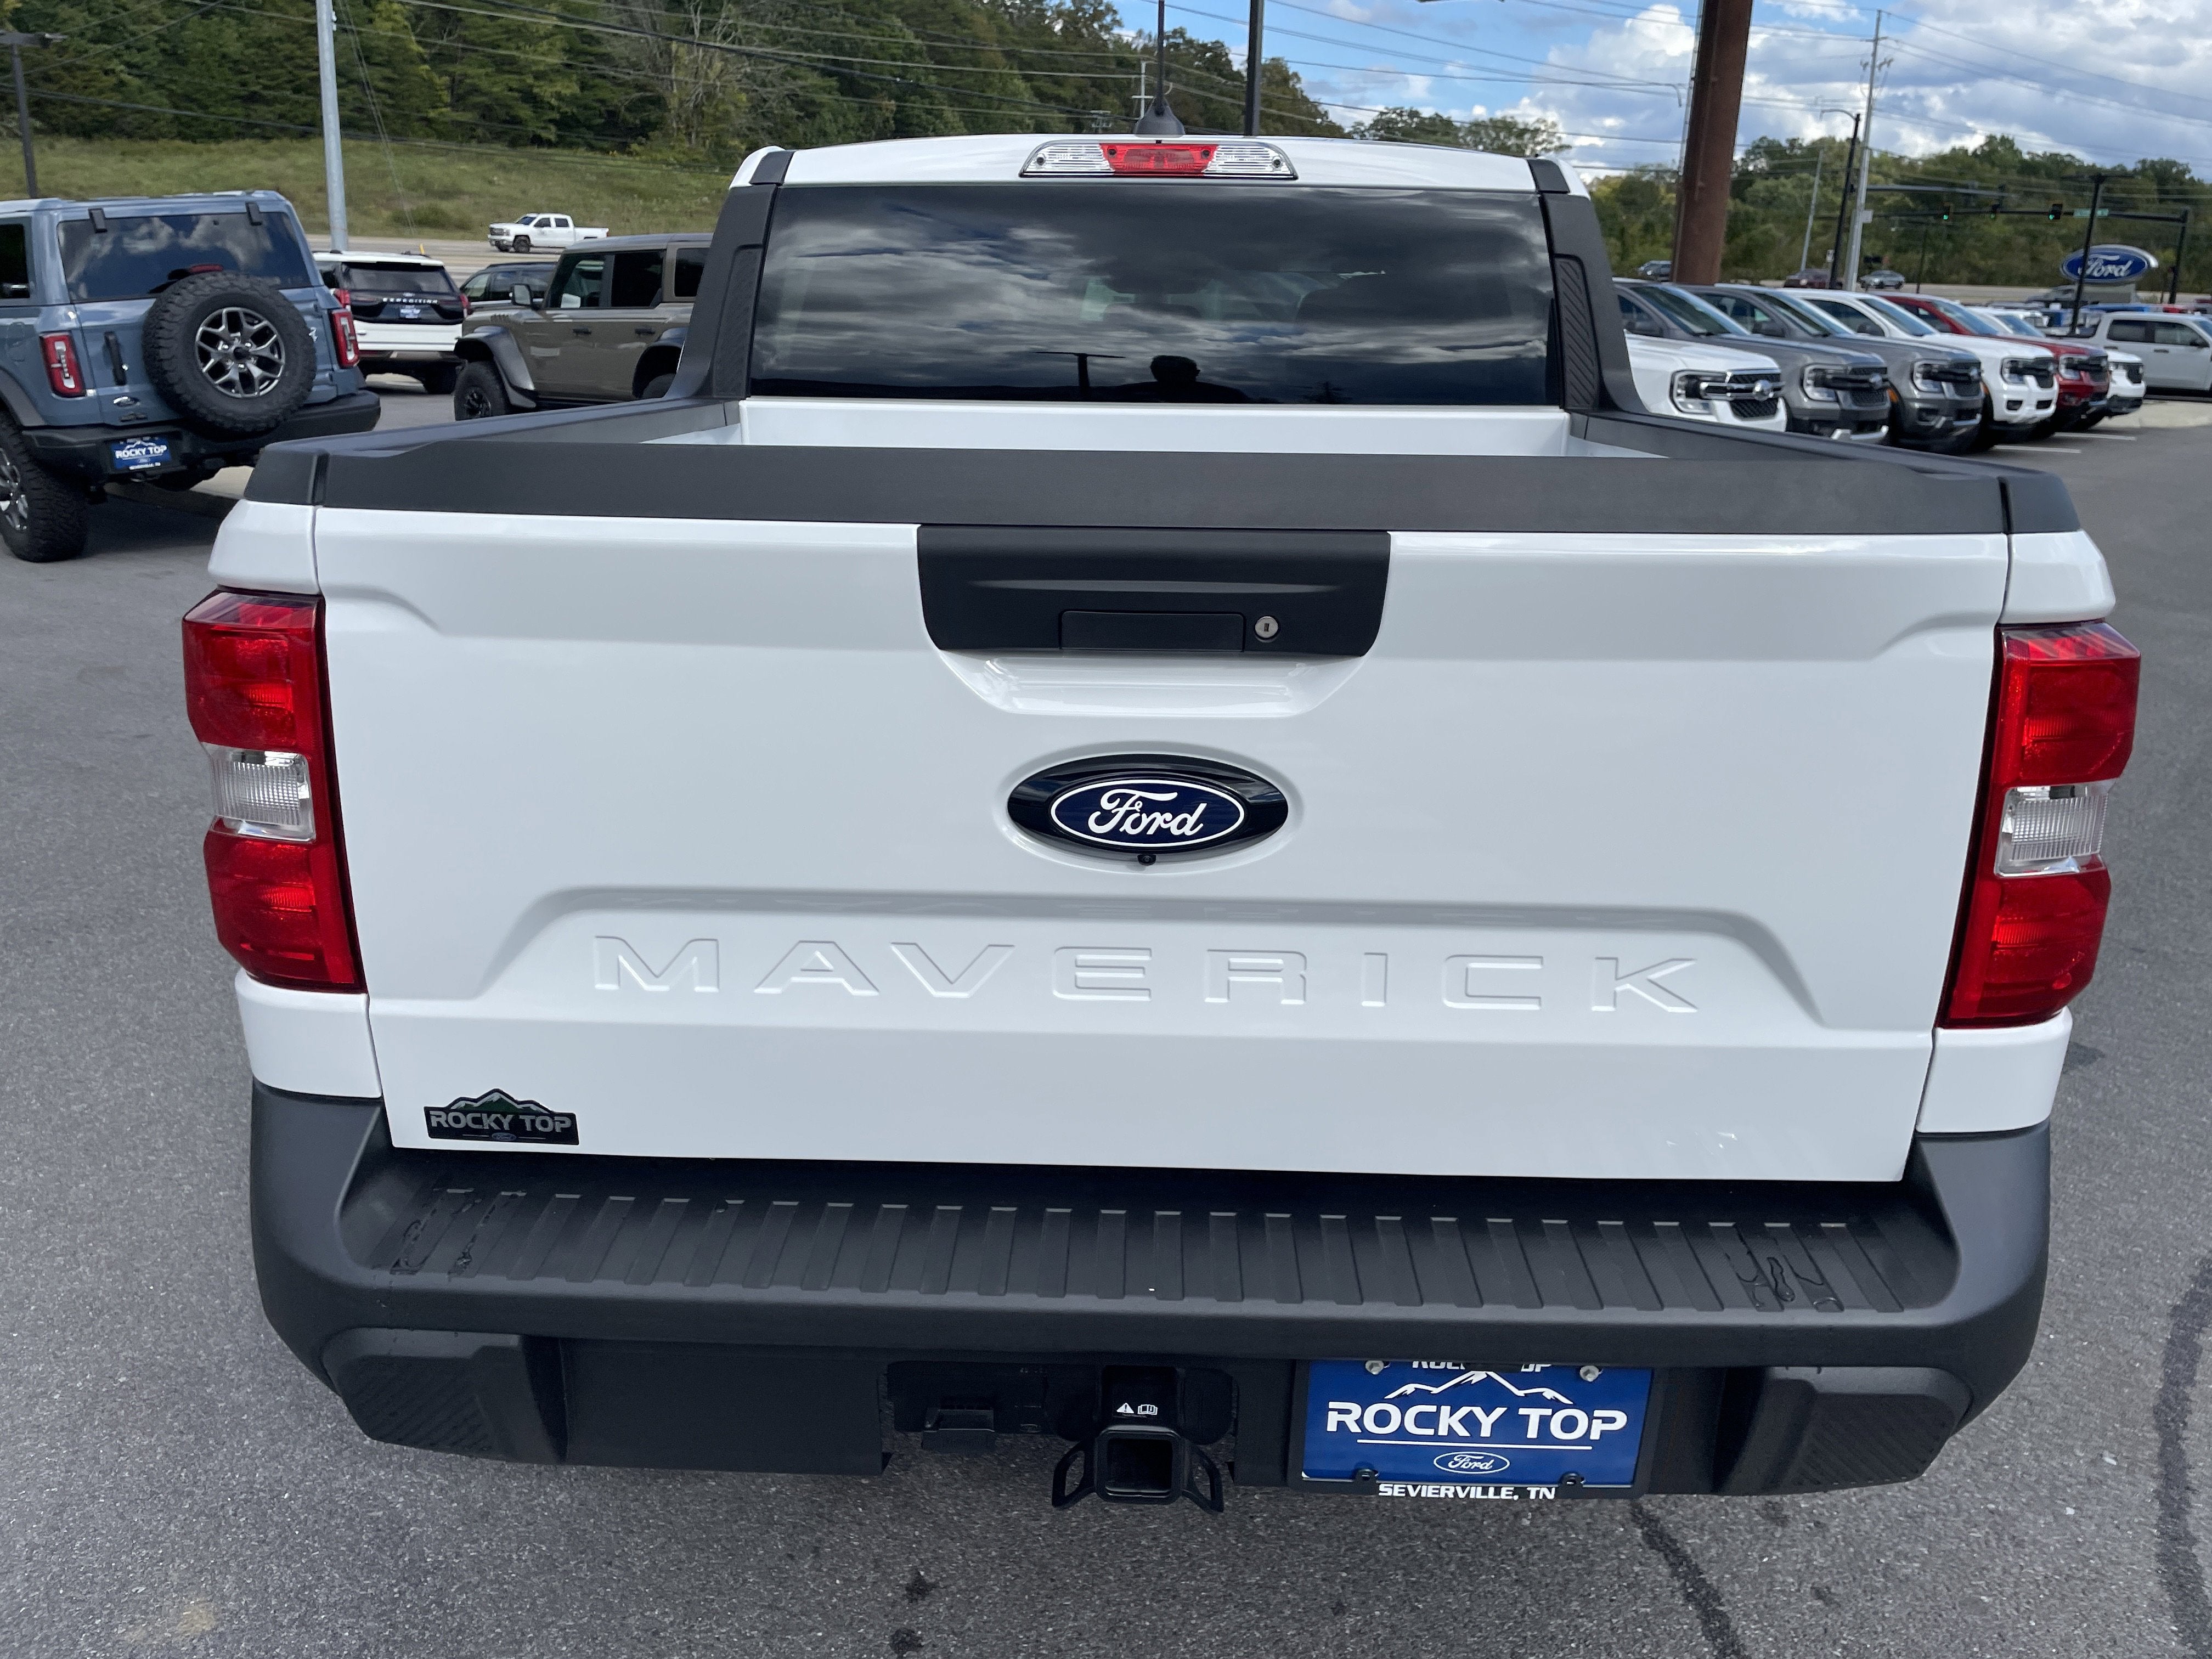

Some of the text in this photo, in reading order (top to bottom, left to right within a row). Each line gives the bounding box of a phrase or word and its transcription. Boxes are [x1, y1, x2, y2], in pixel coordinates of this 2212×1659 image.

[2078, 254, 2133, 276] Ford
[115, 445, 167, 458] ROCKY TOP
[1088, 788, 1207, 836] Ford
[595, 935, 1698, 1013] MAVERICK
[430, 1110, 572, 1133] ROCKY TOP
[1326, 1401, 1628, 1440] ROCKY TOP
[1447, 1451, 1496, 1471] Ford
[1378, 1483, 1556, 1501] SEVIERVILLE, TN
